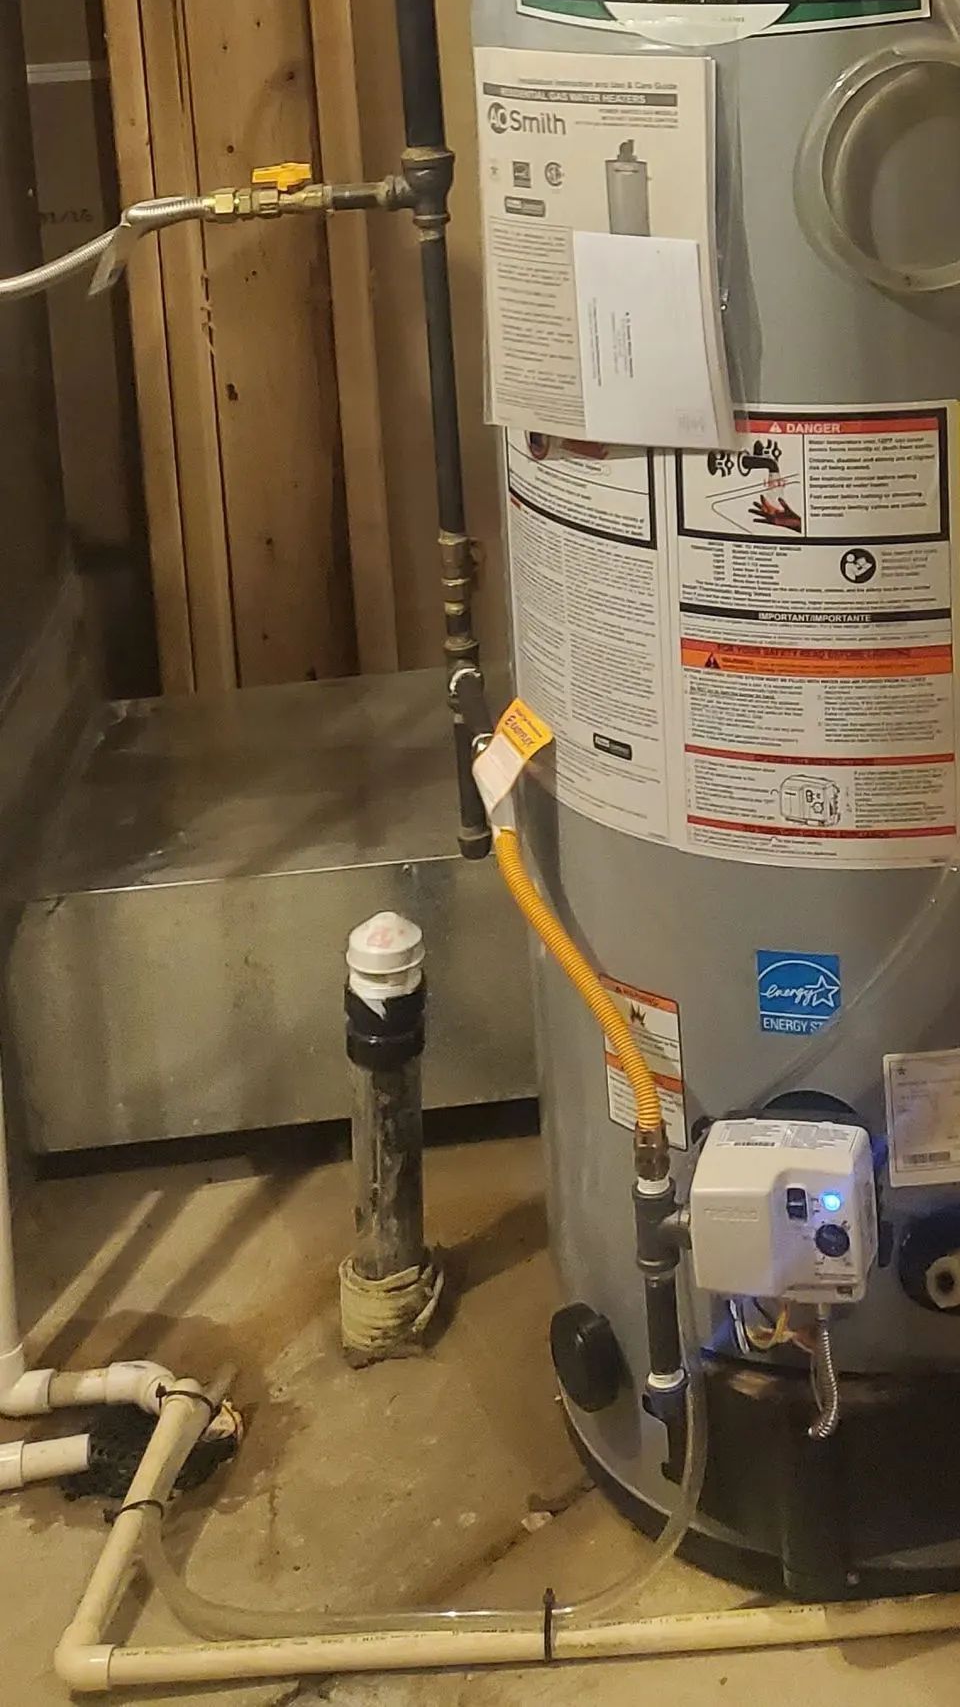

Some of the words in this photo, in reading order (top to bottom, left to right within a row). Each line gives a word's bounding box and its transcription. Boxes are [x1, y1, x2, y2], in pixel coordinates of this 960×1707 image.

[602, 95, 647, 105] HEATERS
[509, 108, 567, 135] Smith
[786, 422, 841, 434] DANGER
[760, 984, 815, 1007] energy
[763, 1017, 808, 1032] ENERGY
